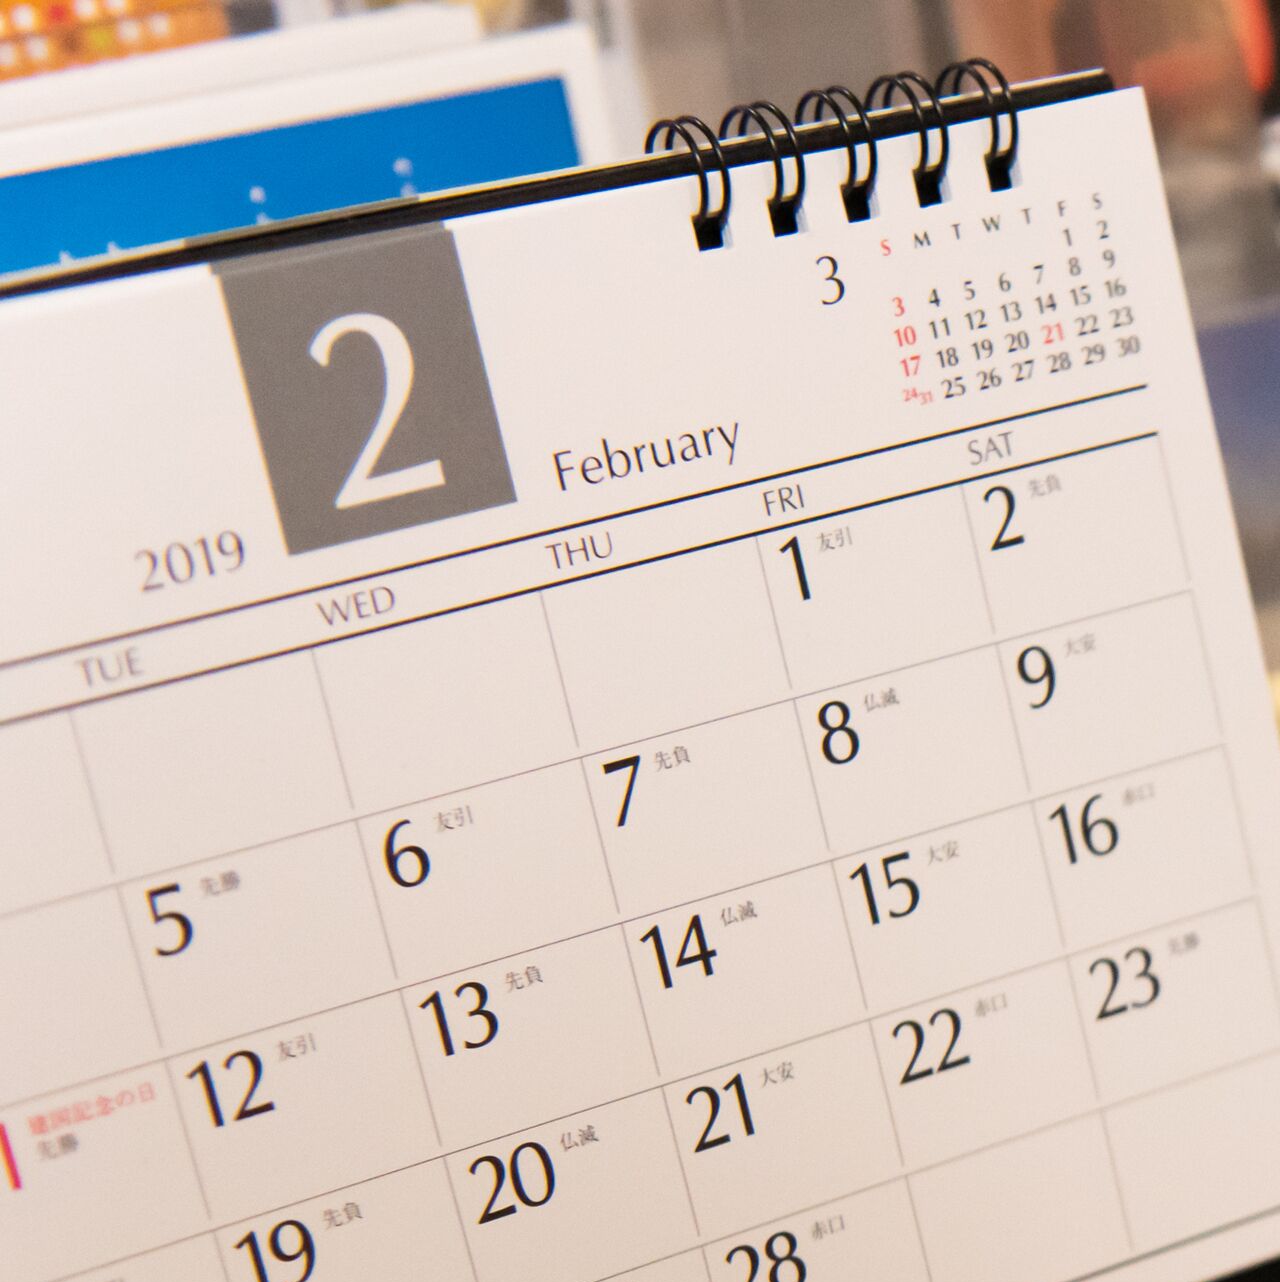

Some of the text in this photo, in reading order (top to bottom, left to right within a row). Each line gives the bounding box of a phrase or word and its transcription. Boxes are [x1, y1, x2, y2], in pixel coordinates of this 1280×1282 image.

[881, 194, 1102, 256] S M T W T F S
[1063, 221, 1109, 246] 1 2
[817, 256, 845, 305] 3
[893, 250, 1115, 316] 3 4 5 6 7 8 9
[894, 279, 1126, 347] 10 11 12 13 14 15 16
[901, 307, 1134, 376] 17 18 19 20 21 22 23
[942, 376, 966, 399] 25
[978, 369, 1002, 390] 26
[1013, 360, 1034, 382] 27
[1047, 352, 1072, 373] 28
[1082, 344, 1105, 365] 29
[1117, 336, 1141, 357] 30
[308, 312, 445, 509] 2
[553, 422, 741, 492] February
[983, 486, 1024, 551] 2
[75, 432, 1012, 688] TUE WED THU FRI SAT
[134, 530, 246, 593] 2019
[779, 536, 811, 600] 1
[1017, 646, 1056, 709] 9
[817, 701, 860, 764] 8
[602, 746, 690, 827] 7 先負
[383, 820, 430, 887] 6
[1050, 795, 1119, 864] 16
[145, 884, 193, 956] 5
[849, 852, 920, 924] 15
[640, 915, 717, 988] 14
[1089, 948, 1160, 1020] 23
[418, 966, 543, 1056] 13 先負
[892, 1009, 970, 1085] 22
[186, 1050, 275, 1127] 12
[686, 1074, 755, 1152] 21
[465, 1142, 555, 1224] 20
